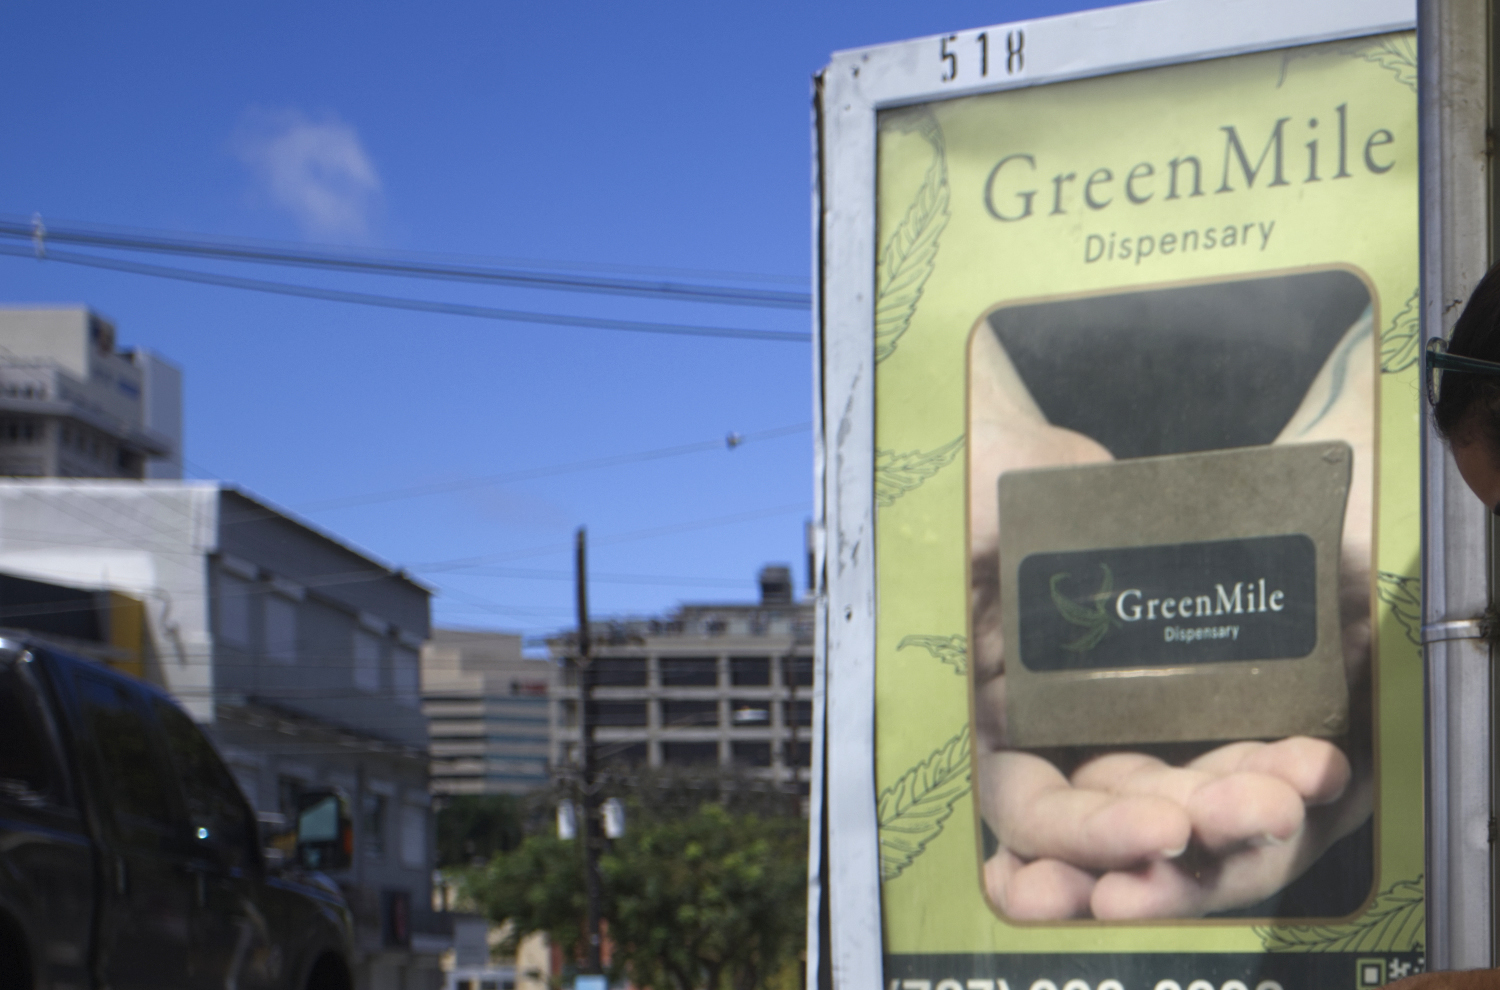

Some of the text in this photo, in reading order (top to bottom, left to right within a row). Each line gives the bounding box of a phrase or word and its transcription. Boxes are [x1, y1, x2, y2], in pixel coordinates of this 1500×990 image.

[939, 29, 1026, 83] 518
[983, 103, 1397, 223] GreenMile
[1084, 217, 1276, 264] Dispensary
[1116, 578, 1285, 622] GreenMile
[1164, 624, 1240, 644] Dispensary
